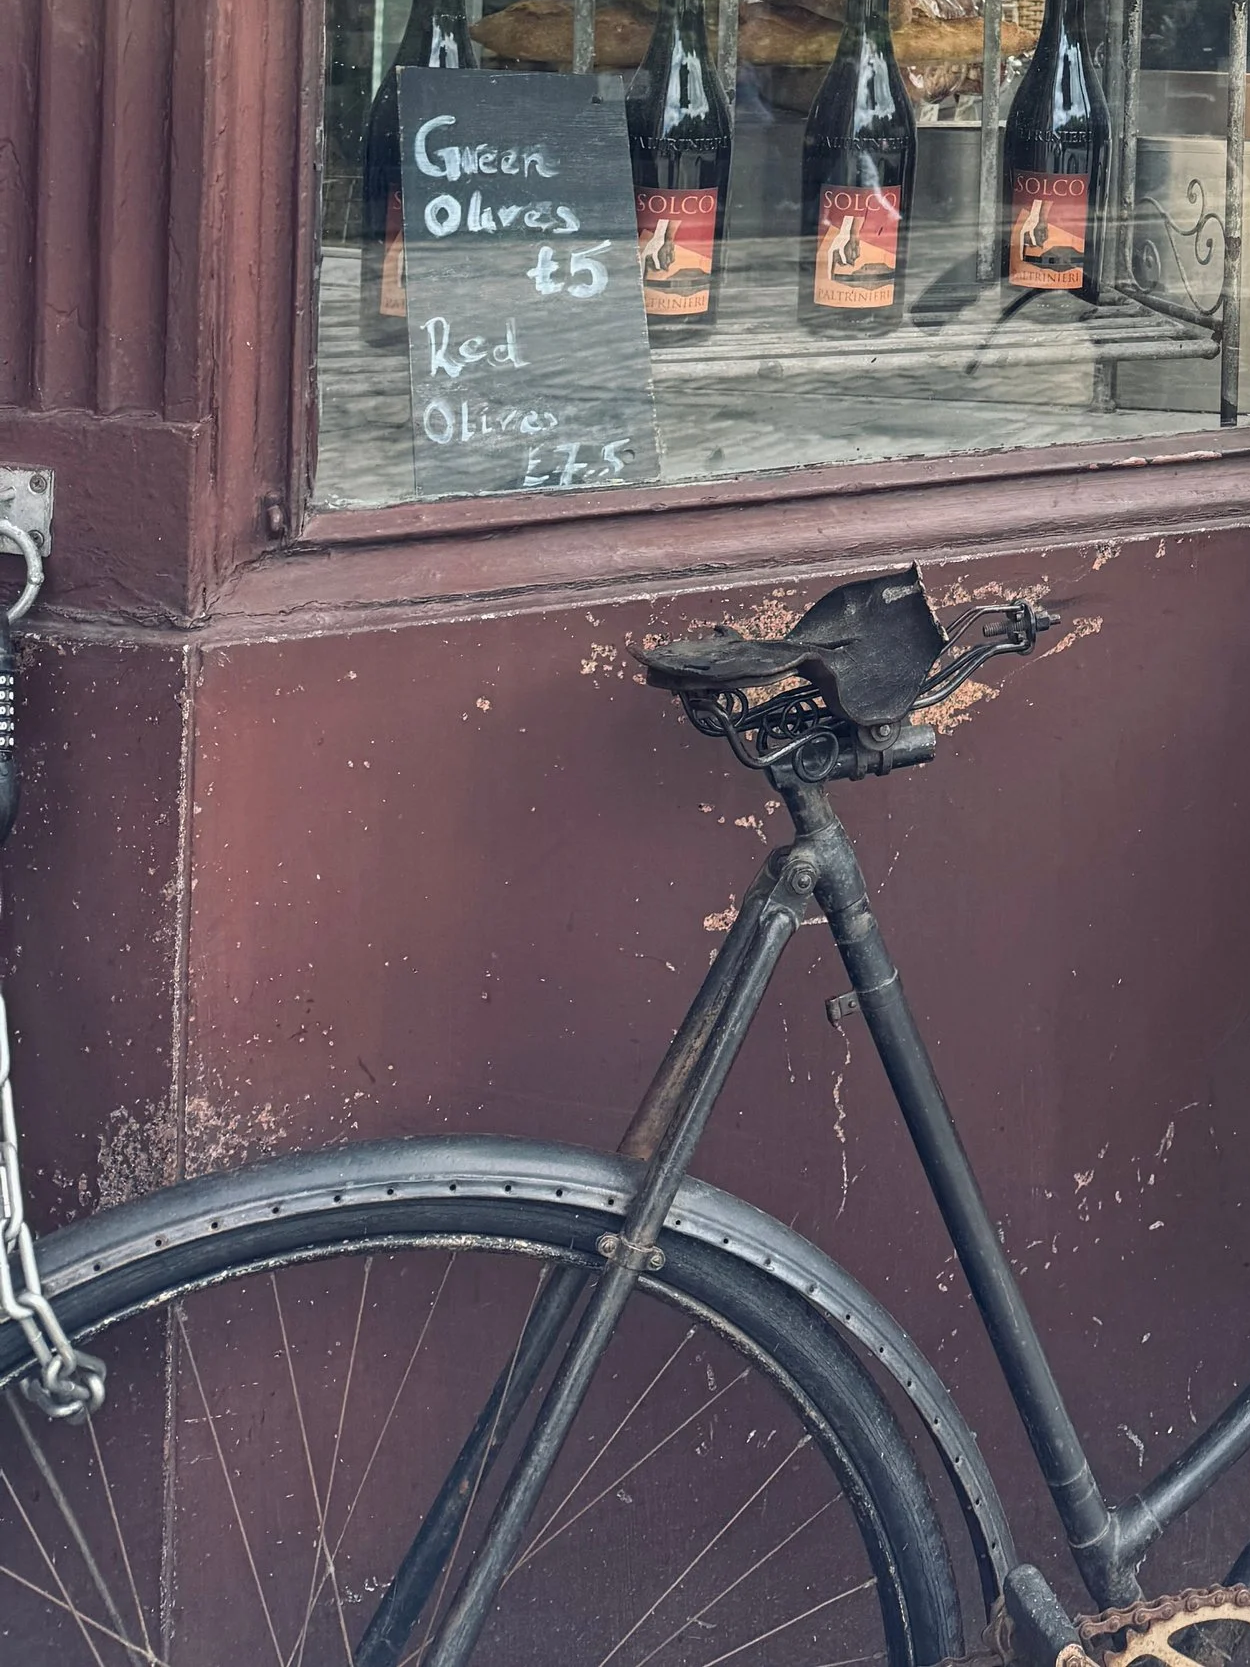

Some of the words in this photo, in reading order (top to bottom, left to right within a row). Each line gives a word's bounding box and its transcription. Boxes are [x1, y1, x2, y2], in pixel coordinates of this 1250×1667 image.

[414, 115, 561, 181] Green
[824, 191, 896, 211] SOLCO
[1015, 175, 1084, 196] SOLCO
[425, 191, 581, 236] Olives
[637, 194, 714, 214] SOLCO
[817, 288, 890, 302] PALTRINIERI
[421, 317, 531, 377] Red
[423, 400, 559, 445] Olives
